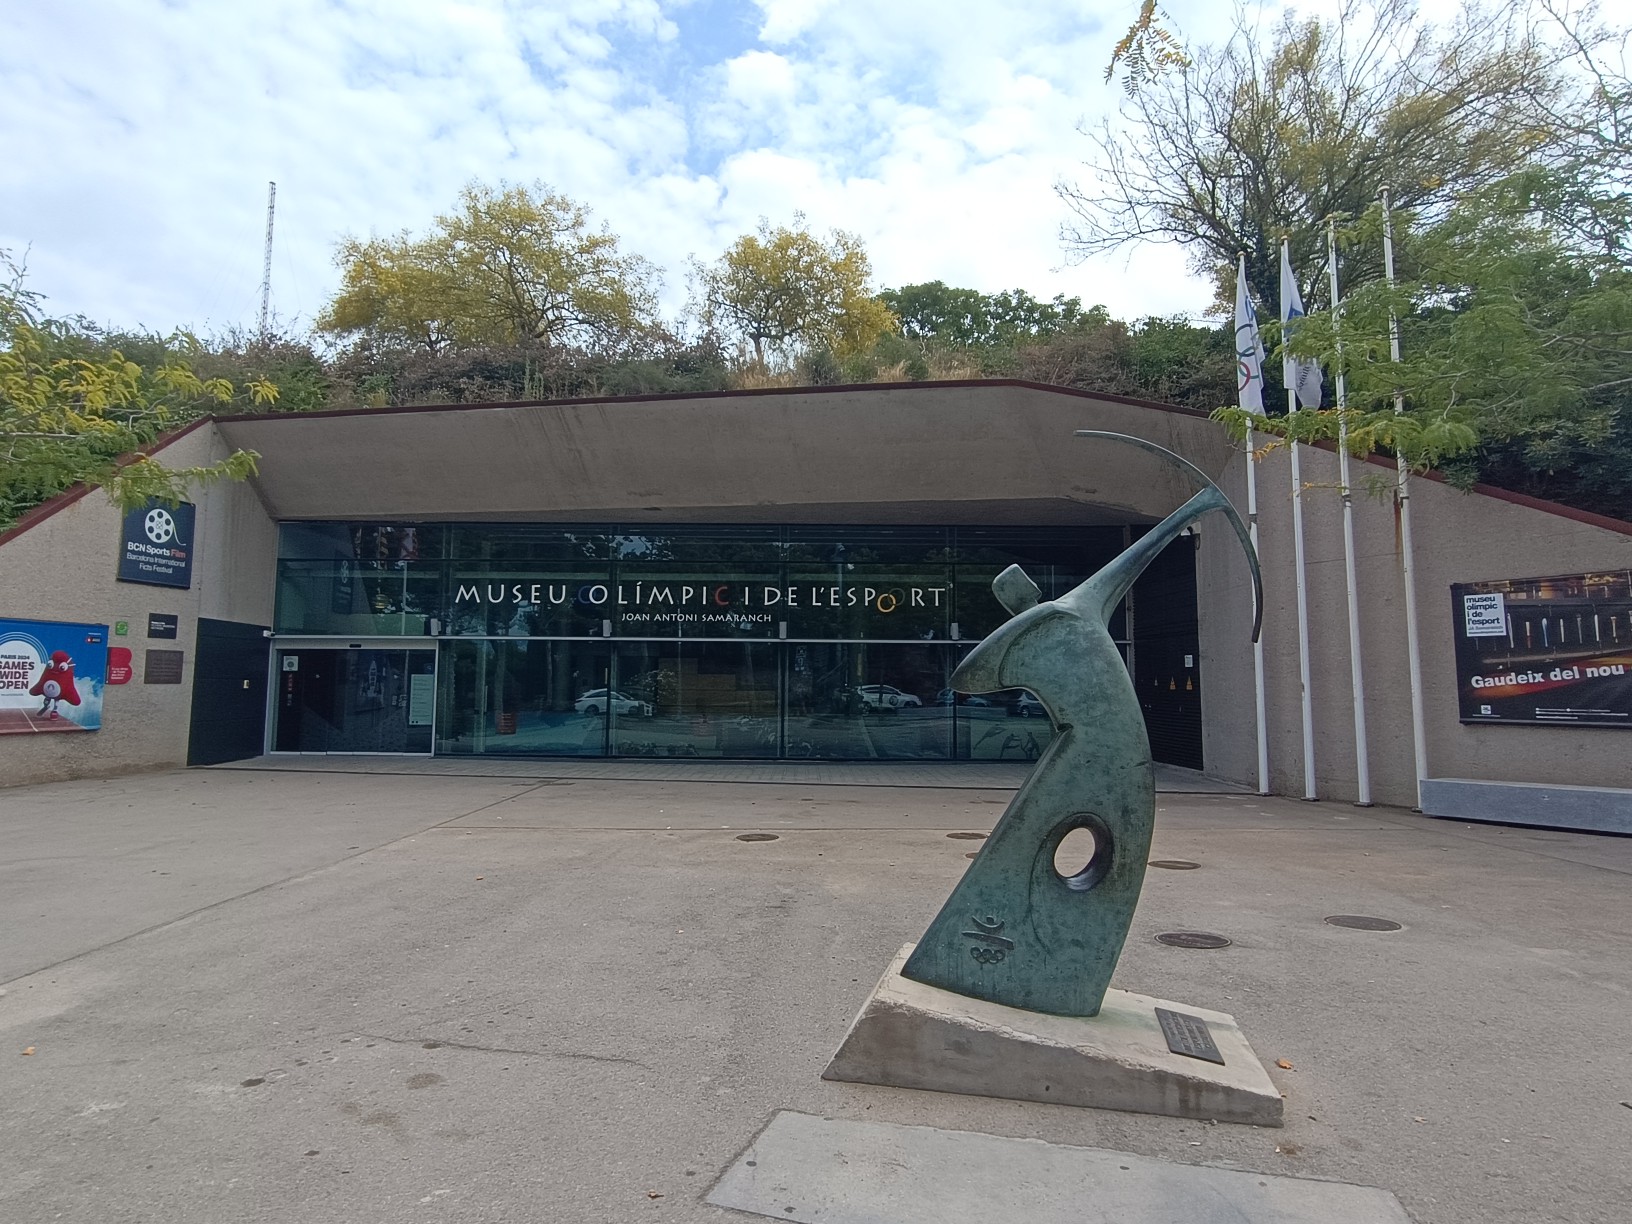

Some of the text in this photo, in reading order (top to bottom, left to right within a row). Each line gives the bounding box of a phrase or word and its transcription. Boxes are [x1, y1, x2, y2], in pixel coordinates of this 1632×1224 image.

[127, 541, 146, 552] BCN
[146, 544, 171, 556] Sports
[154, 556, 186, 568] International
[152, 564, 173, 574] Festival
[455, 584, 566, 604] MUSEU
[588, 581, 730, 605] OLÍMPIC
[744, 586, 749, 606] I
[764, 587, 798, 606] DE
[621, 613, 772, 622] JOAN ANTONI SAMARANCH
[1471, 610, 1483, 618] de
[1467, 617, 1500, 626] l'esport
[0, 670, 29, 680] WIDE
[1471, 664, 1625, 689] Gaudeix del nou
